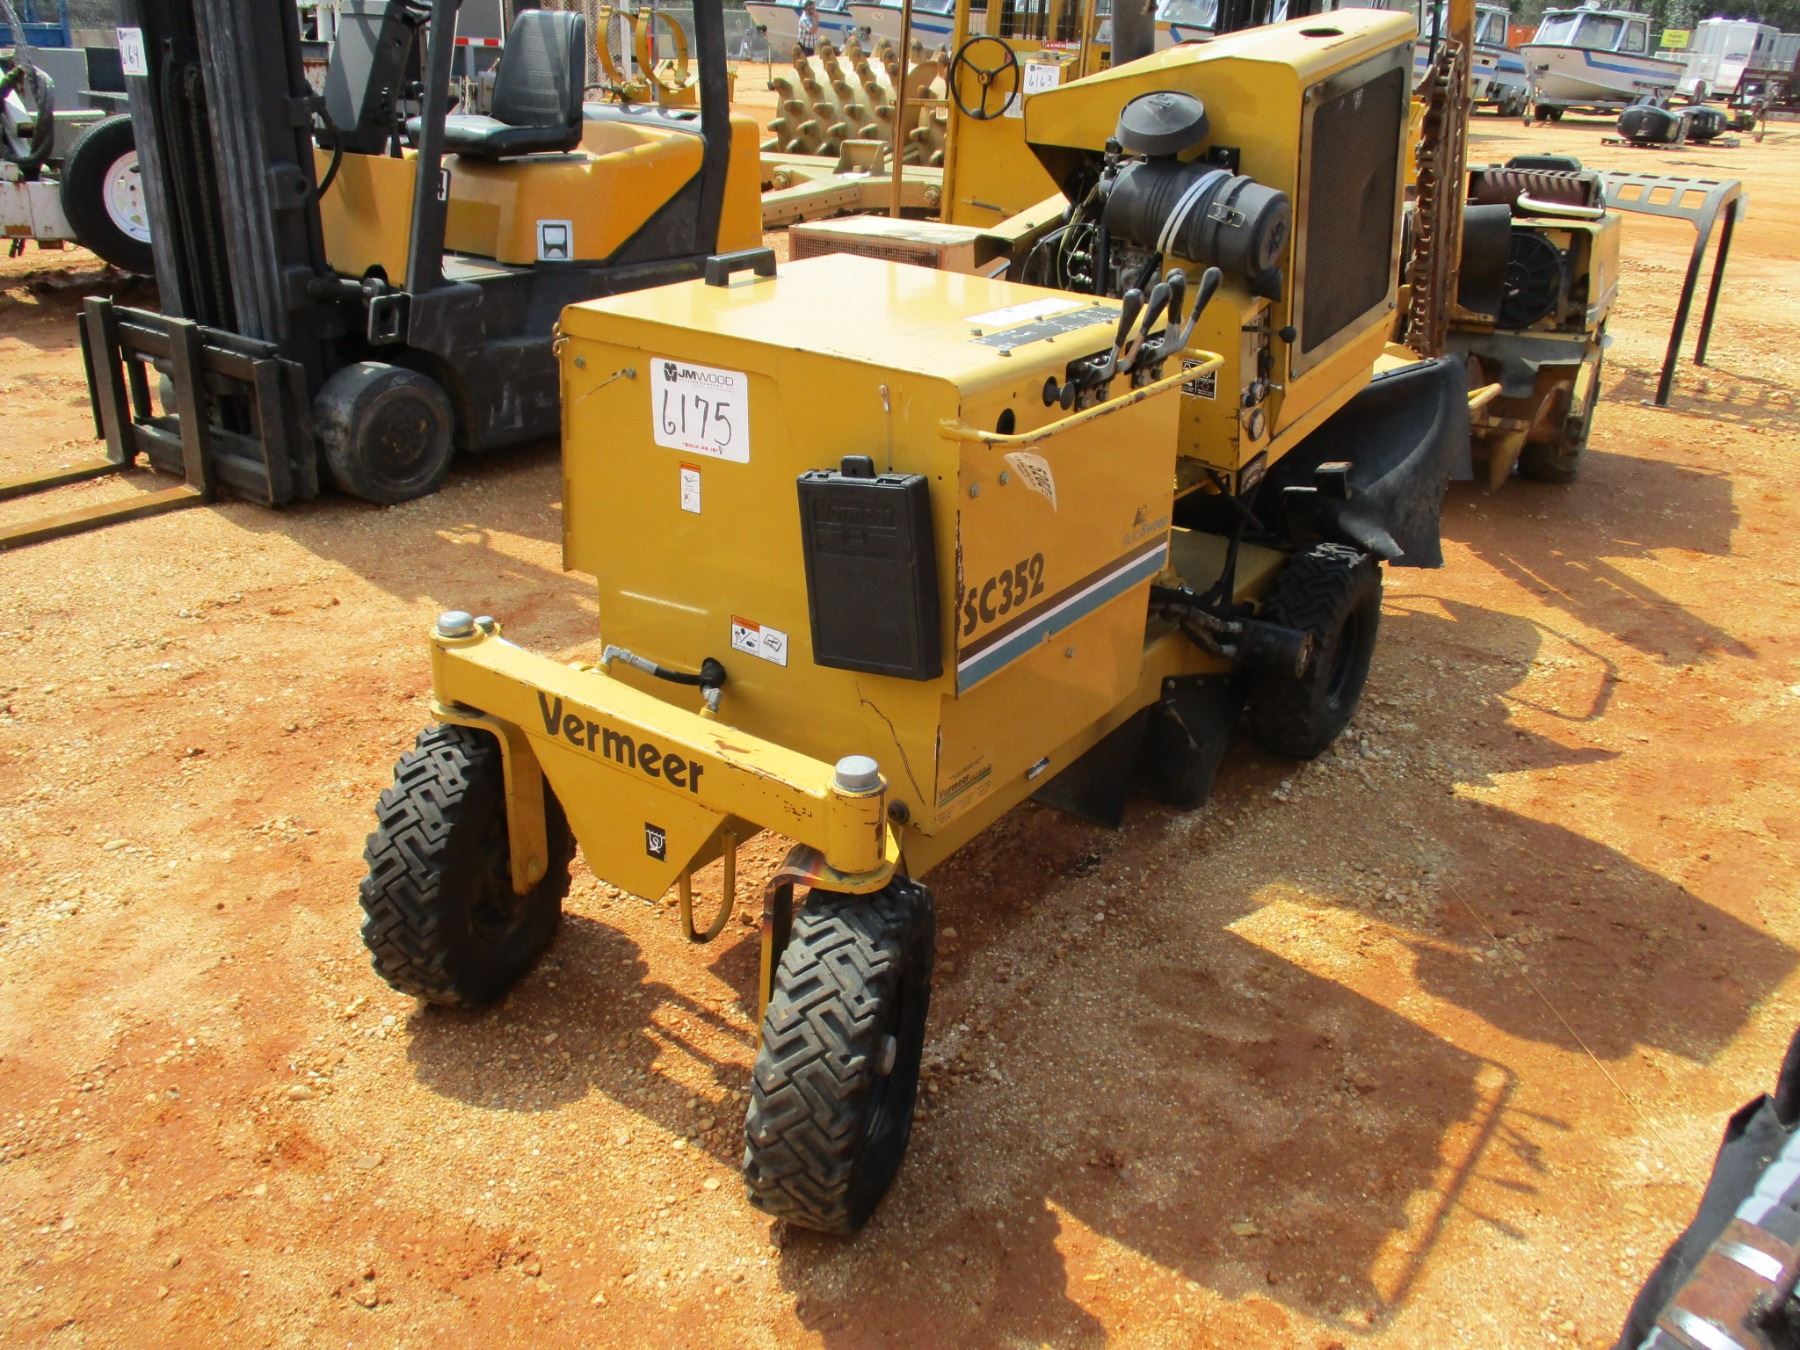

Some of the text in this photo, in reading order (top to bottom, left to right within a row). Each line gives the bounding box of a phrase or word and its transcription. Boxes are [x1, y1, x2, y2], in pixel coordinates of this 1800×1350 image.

[1028, 74, 1053, 88] 6163
[662, 388, 732, 447] 6175
[963, 552, 1045, 637] SC352
[536, 689, 704, 794] Vermeer
